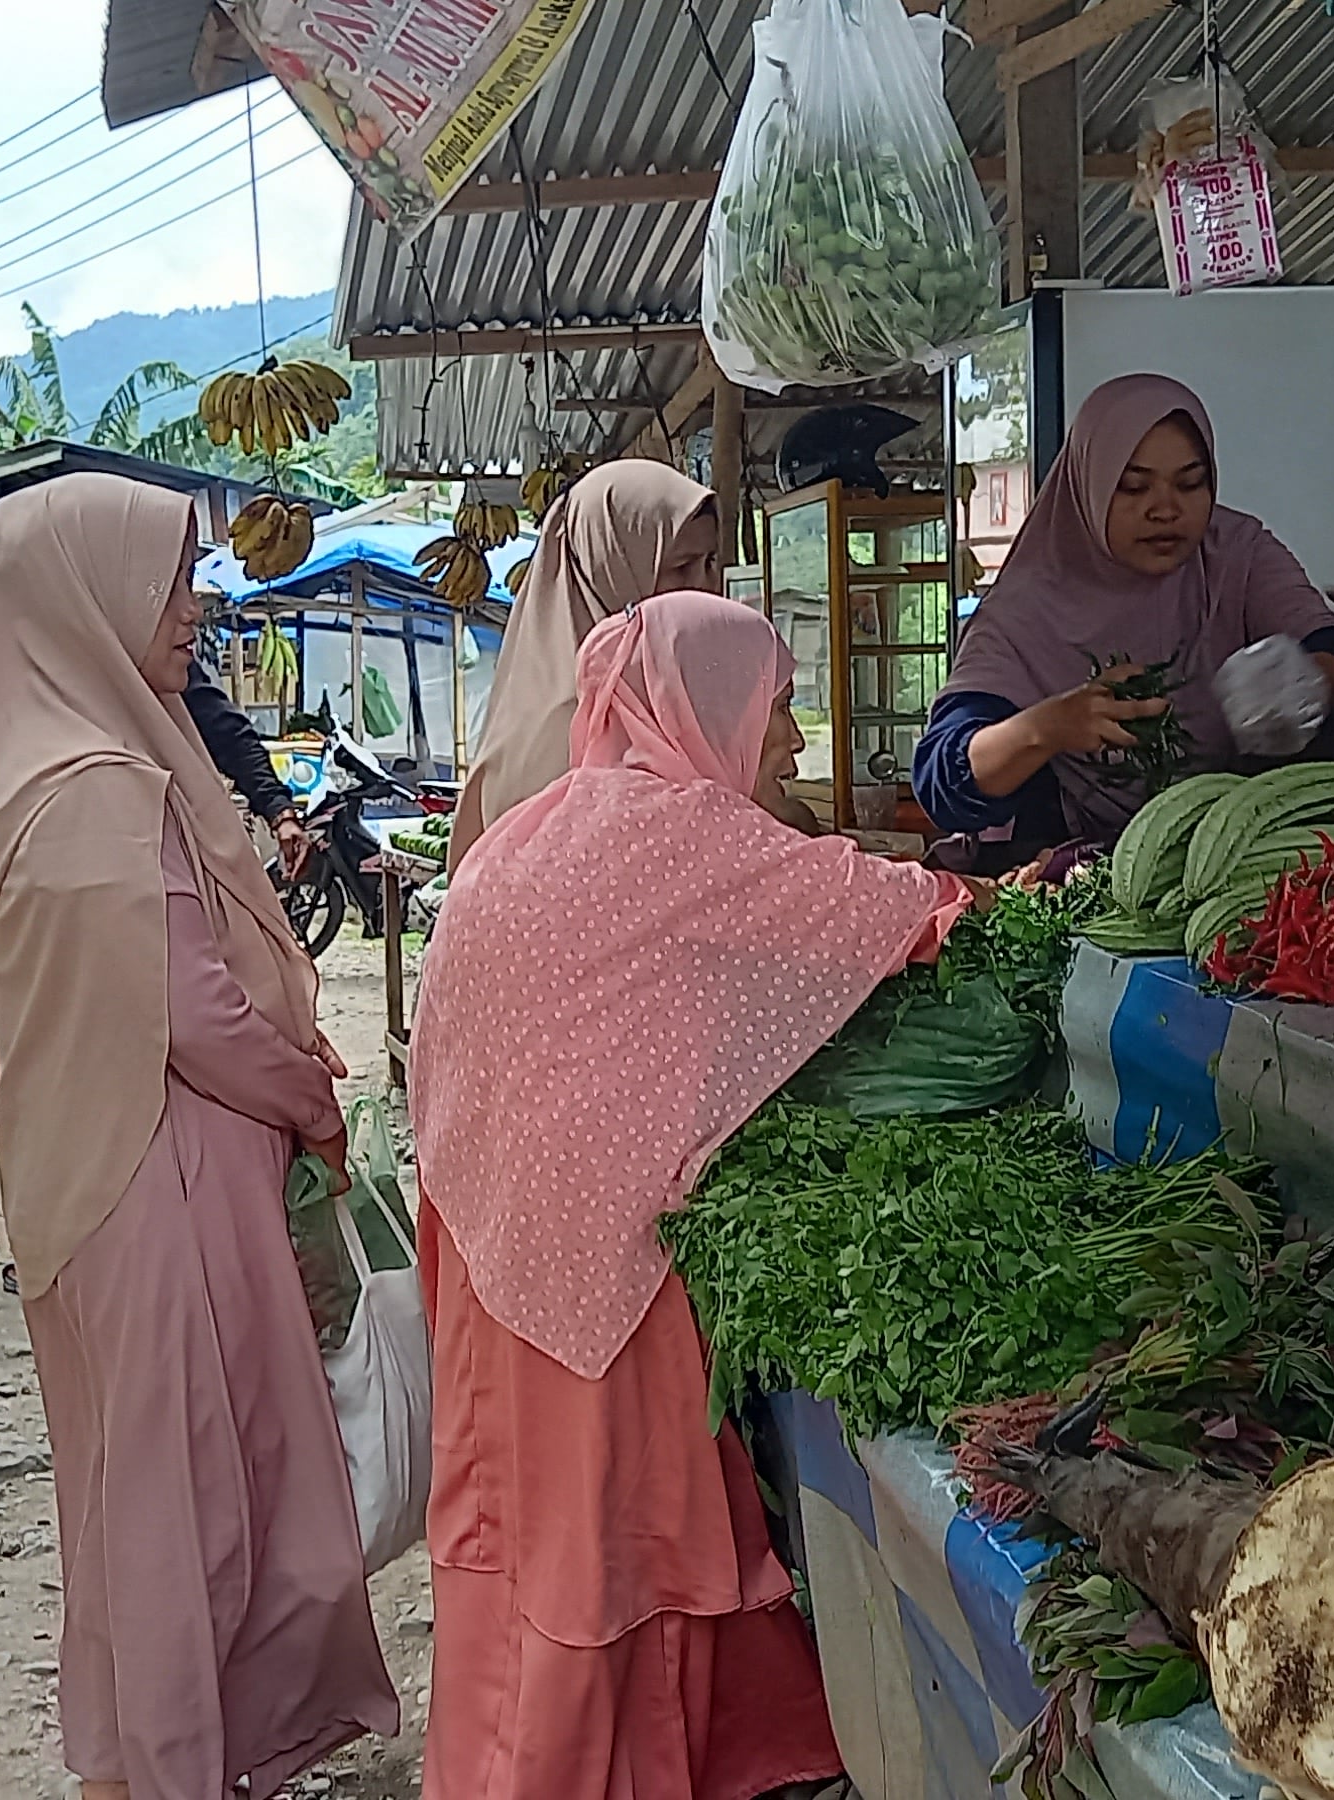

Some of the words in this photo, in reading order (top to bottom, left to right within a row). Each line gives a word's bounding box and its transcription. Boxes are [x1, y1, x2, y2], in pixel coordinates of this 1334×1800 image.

[424, 124, 473, 182] Menjual
[456, 102, 496, 140] Aneka
[525, 0, 574, 38] Anek
[1209, 241, 1243, 263] 100
